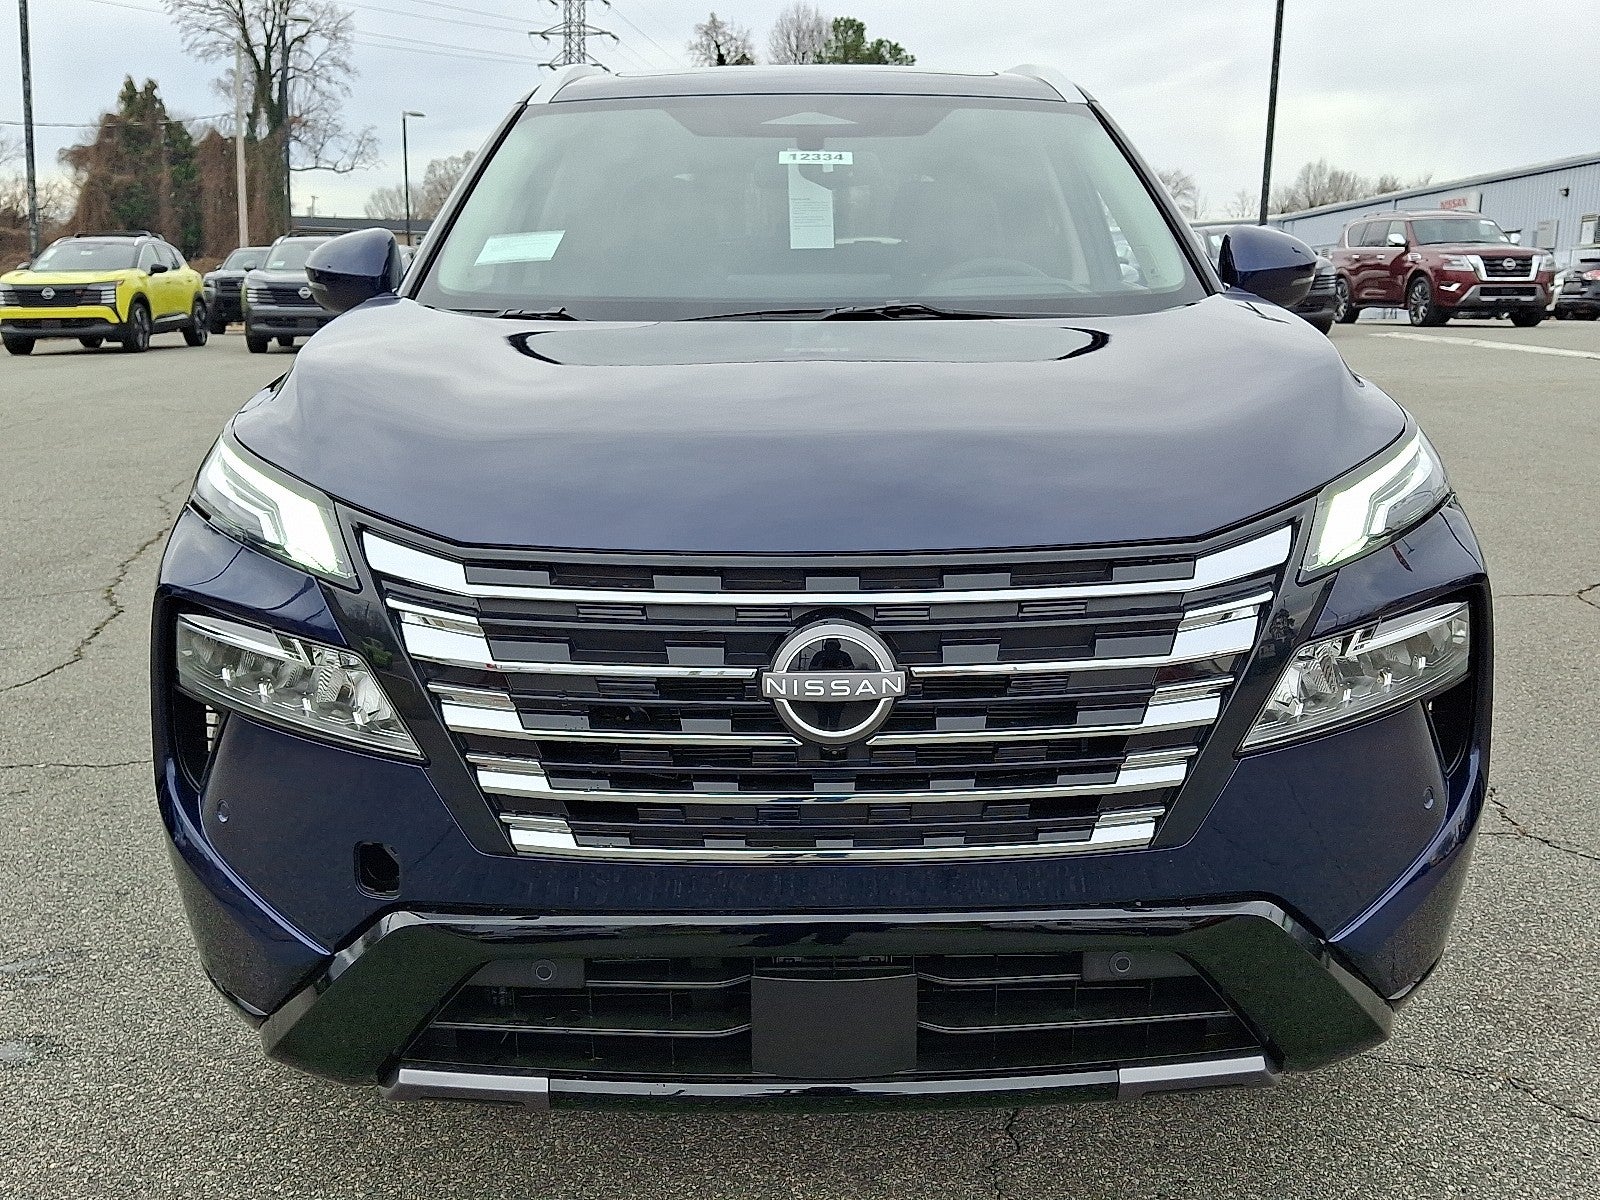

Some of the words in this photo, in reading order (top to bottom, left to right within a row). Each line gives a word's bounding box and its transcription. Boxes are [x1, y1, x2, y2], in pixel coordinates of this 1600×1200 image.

[789, 153, 845, 161] 12334
[1440, 197, 1468, 210] NISSAN
[766, 677, 902, 696] NISSAN
